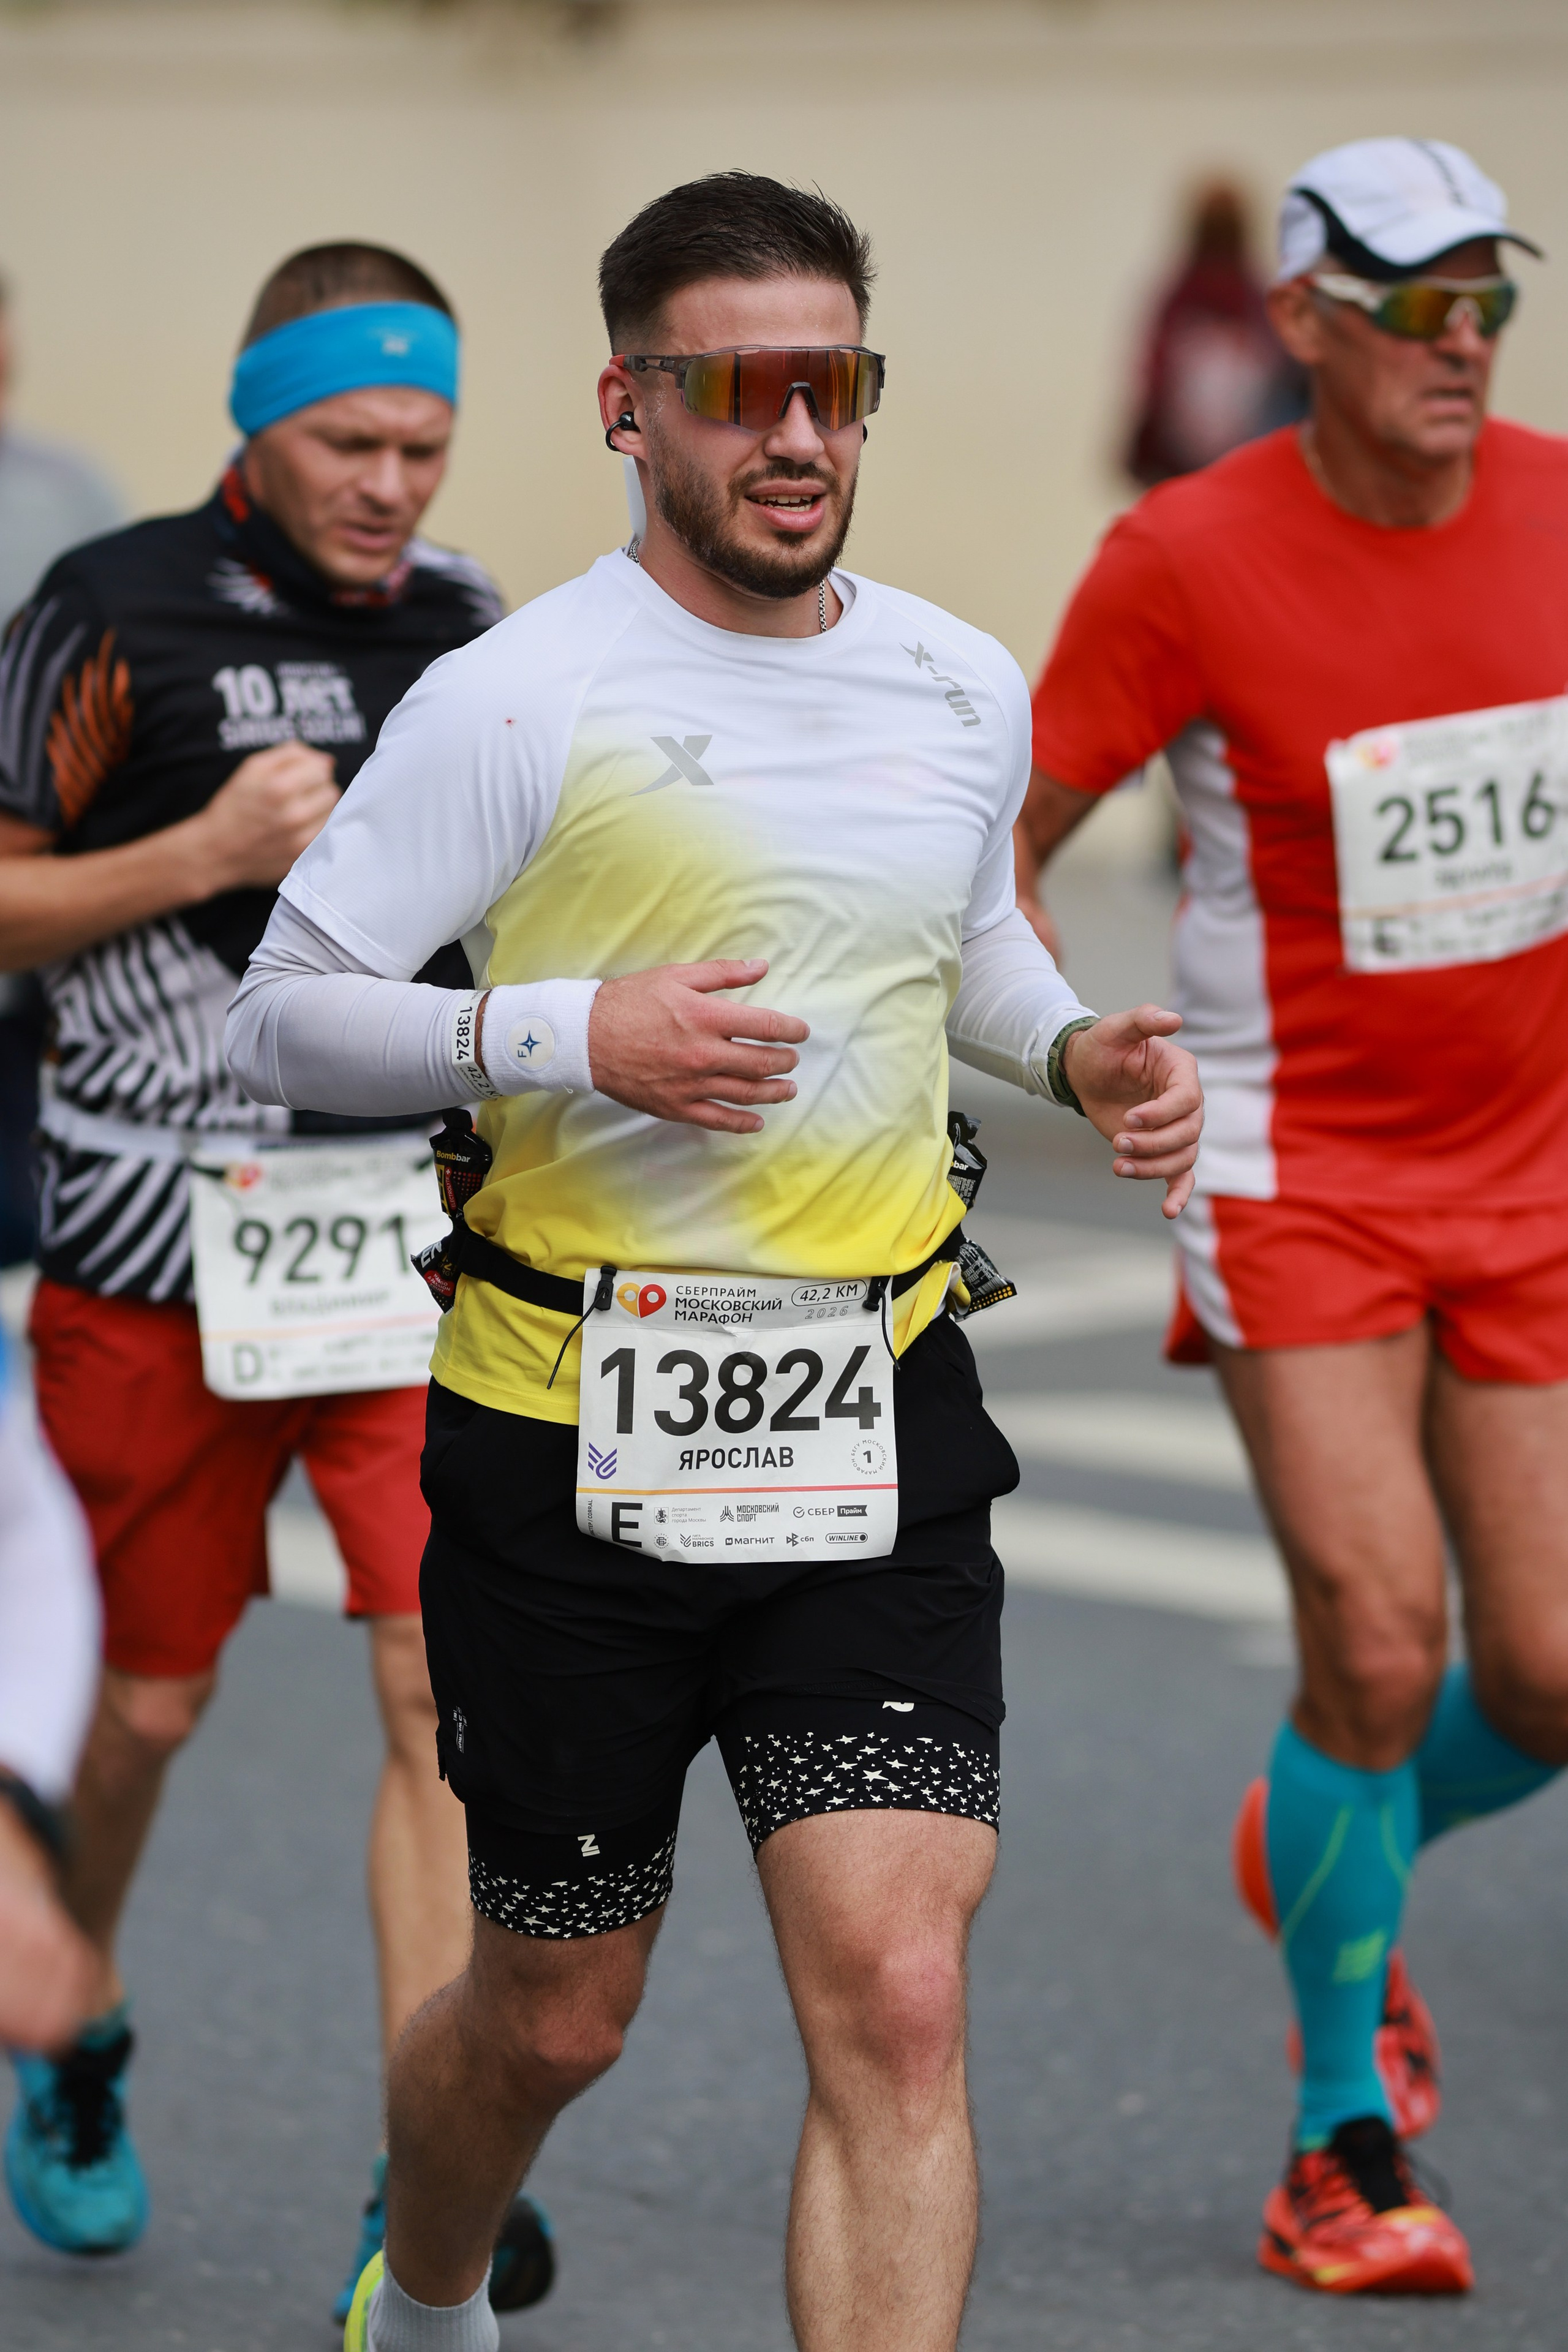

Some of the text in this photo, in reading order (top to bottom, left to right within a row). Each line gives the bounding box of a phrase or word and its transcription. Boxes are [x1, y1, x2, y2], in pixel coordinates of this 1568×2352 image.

[211, 664, 277, 718] 10
[1376, 771, 1556, 864] 2516
[456, 1006, 473, 1061] 13824
[467, 1066, 490, 1088] 42,2
[436, 1150, 471, 1163] Bombbar
[232, 1212, 411, 1284] 9291
[431, 1278, 451, 1292] PASSION
[434, 1273, 448, 1286] MANGO
[676, 1285, 756, 1298] СБЕРПРАЙМ
[800, 1287, 831, 1302] 42,2
[675, 1297, 782, 1311] МОСКОВСКИЙ
[674, 1310, 753, 1325] МАРАФОН
[805, 1305, 849, 1319] 2026
[600, 1344, 882, 1436] 13824
[679, 1447, 794, 1471] ЯРОСЛАВ
[851, 1439, 887, 1475] БЕГУ МОСКОВСКИЙ МАРАФОН
[862, 1450, 872, 1463] 1
[736, 1502, 779, 1513] МОСКОВСКИЙ
[611, 1502, 643, 1548] E
[737, 1513, 757, 1522] СПОРТ
[458, 1722, 462, 1732] WE
